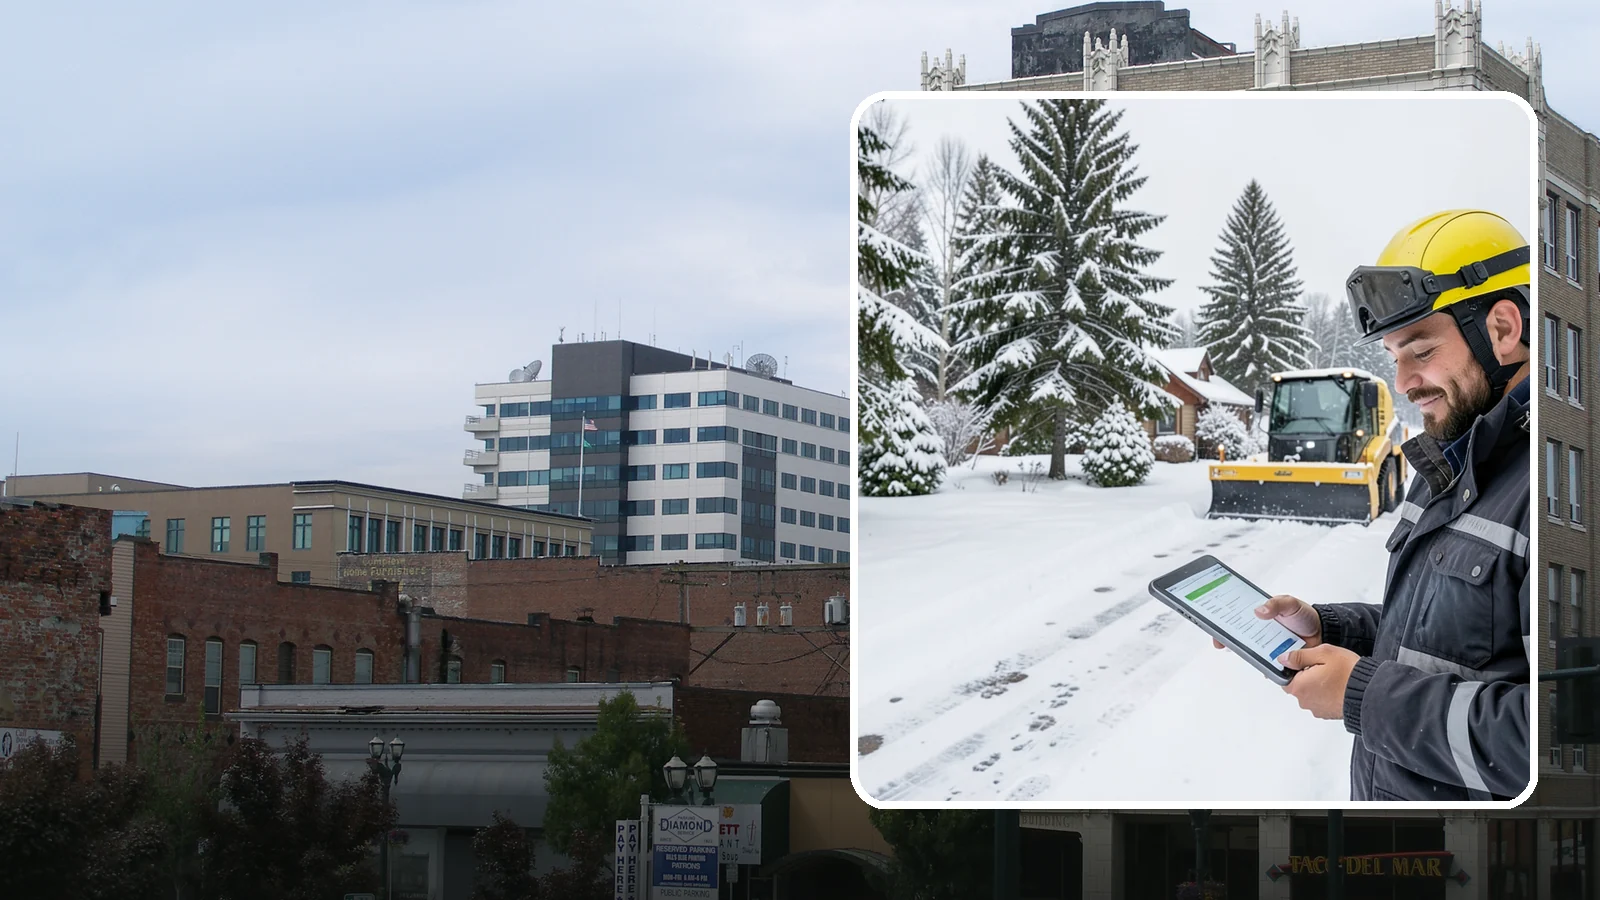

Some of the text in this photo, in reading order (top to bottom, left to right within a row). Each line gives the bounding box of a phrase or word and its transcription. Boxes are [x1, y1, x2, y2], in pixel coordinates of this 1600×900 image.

[344, 566, 427, 577] Home Furnishers
[660, 818, 713, 832] DIAMOND
[1022, 815, 1070, 828] BUILDING
[690, 846, 716, 854] PARKING
[722, 852, 738, 862] Soup
[1290, 856, 1442, 877] TAC DEL MAR
[616, 856, 625, 894] HERE
[628, 856, 636, 894] HERE
[660, 888, 710, 898] PUBLIC PARKING
